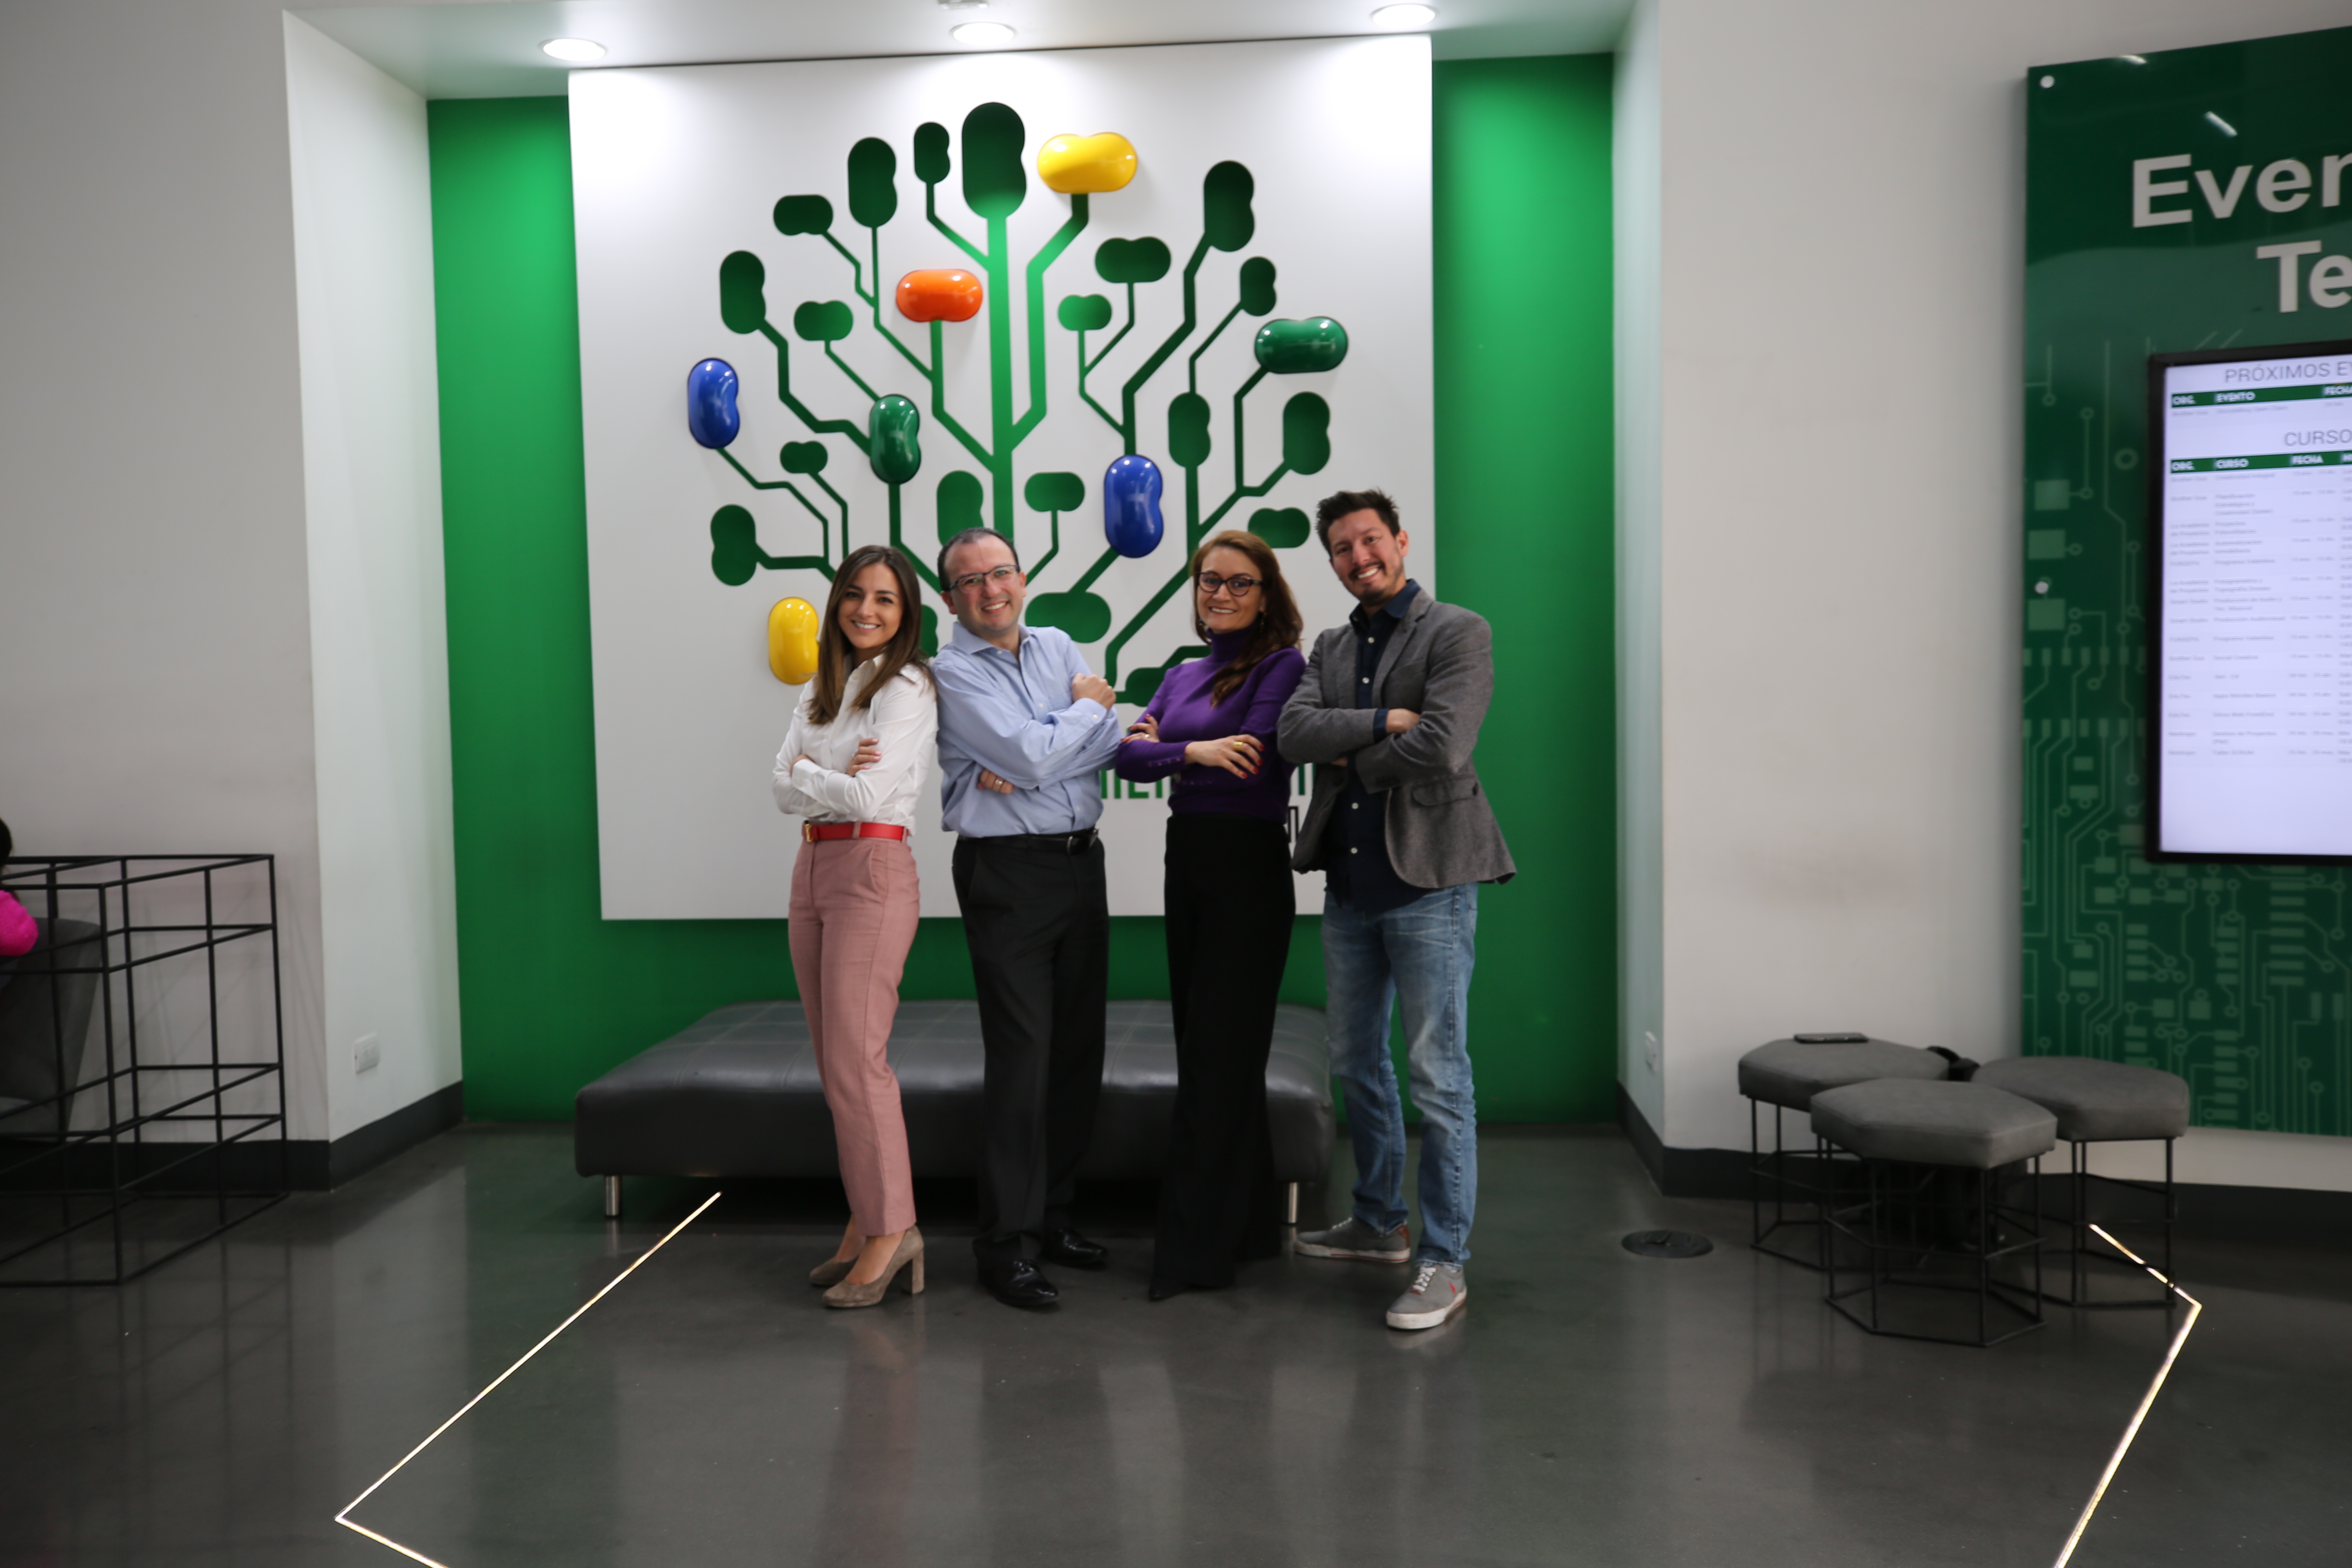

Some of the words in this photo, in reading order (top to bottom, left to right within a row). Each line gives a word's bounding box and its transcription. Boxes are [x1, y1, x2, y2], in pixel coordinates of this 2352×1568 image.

[2256, 240, 2352, 313] Te
[2225, 362, 2331, 383] PRÓXIMOS
[2285, 428, 2352, 446] CURSO
